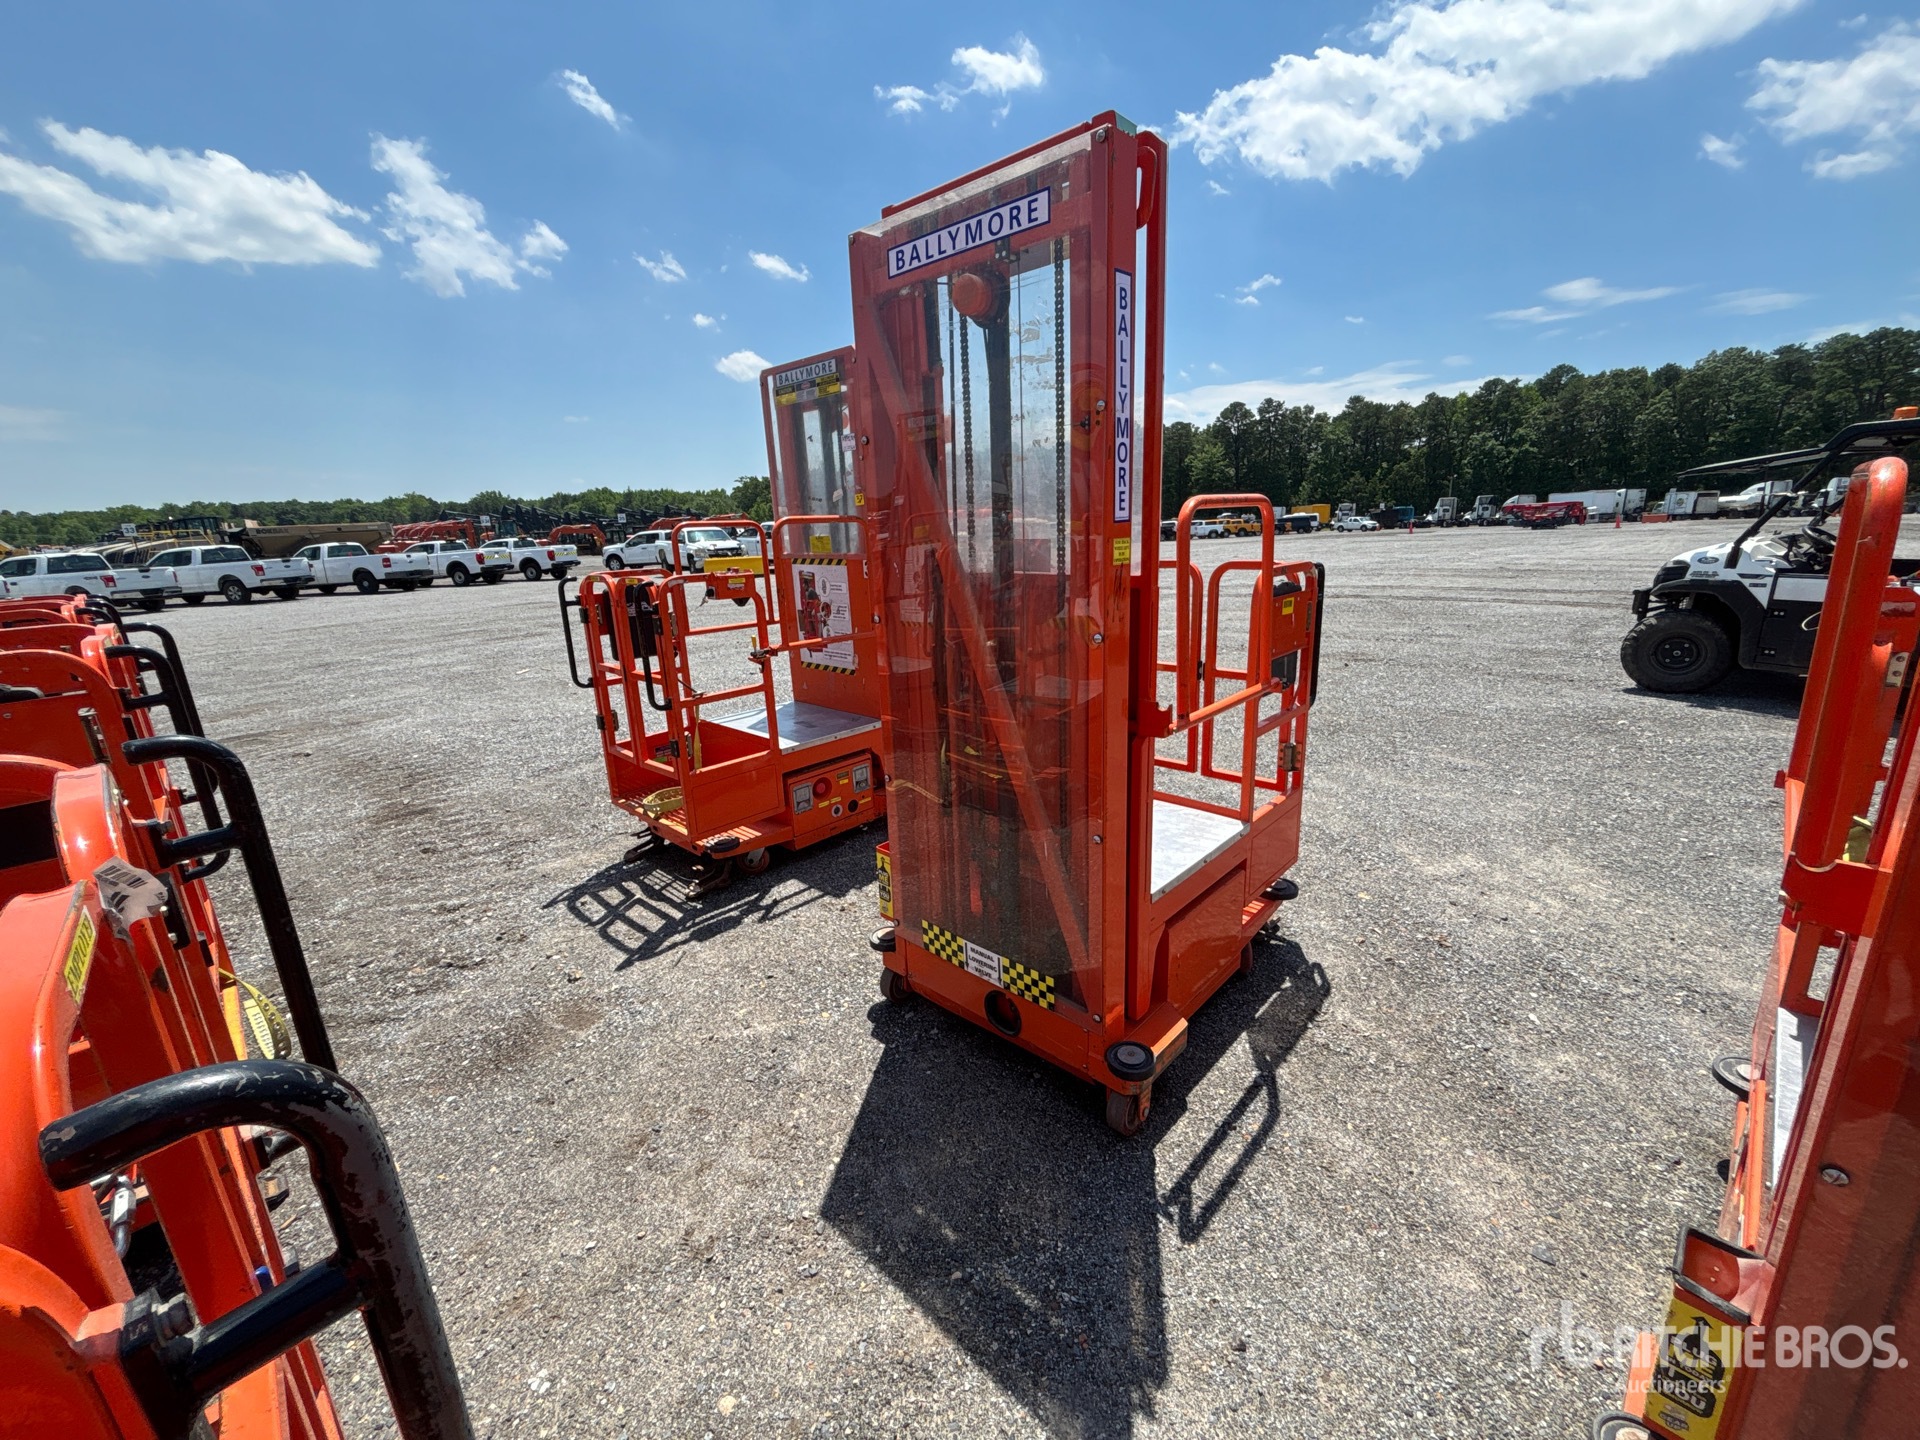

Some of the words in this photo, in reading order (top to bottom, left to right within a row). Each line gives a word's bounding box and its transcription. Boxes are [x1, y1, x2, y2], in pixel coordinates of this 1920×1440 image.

[895, 197, 1039, 272] BALLYMORE
[778, 360, 834, 386] BALLYMORE
[1116, 286, 1129, 512] BALLYMORE
[968, 954, 998, 973] LOWERING
[970, 946, 995, 963] MANUAL
[974, 966, 993, 979] VALVE
